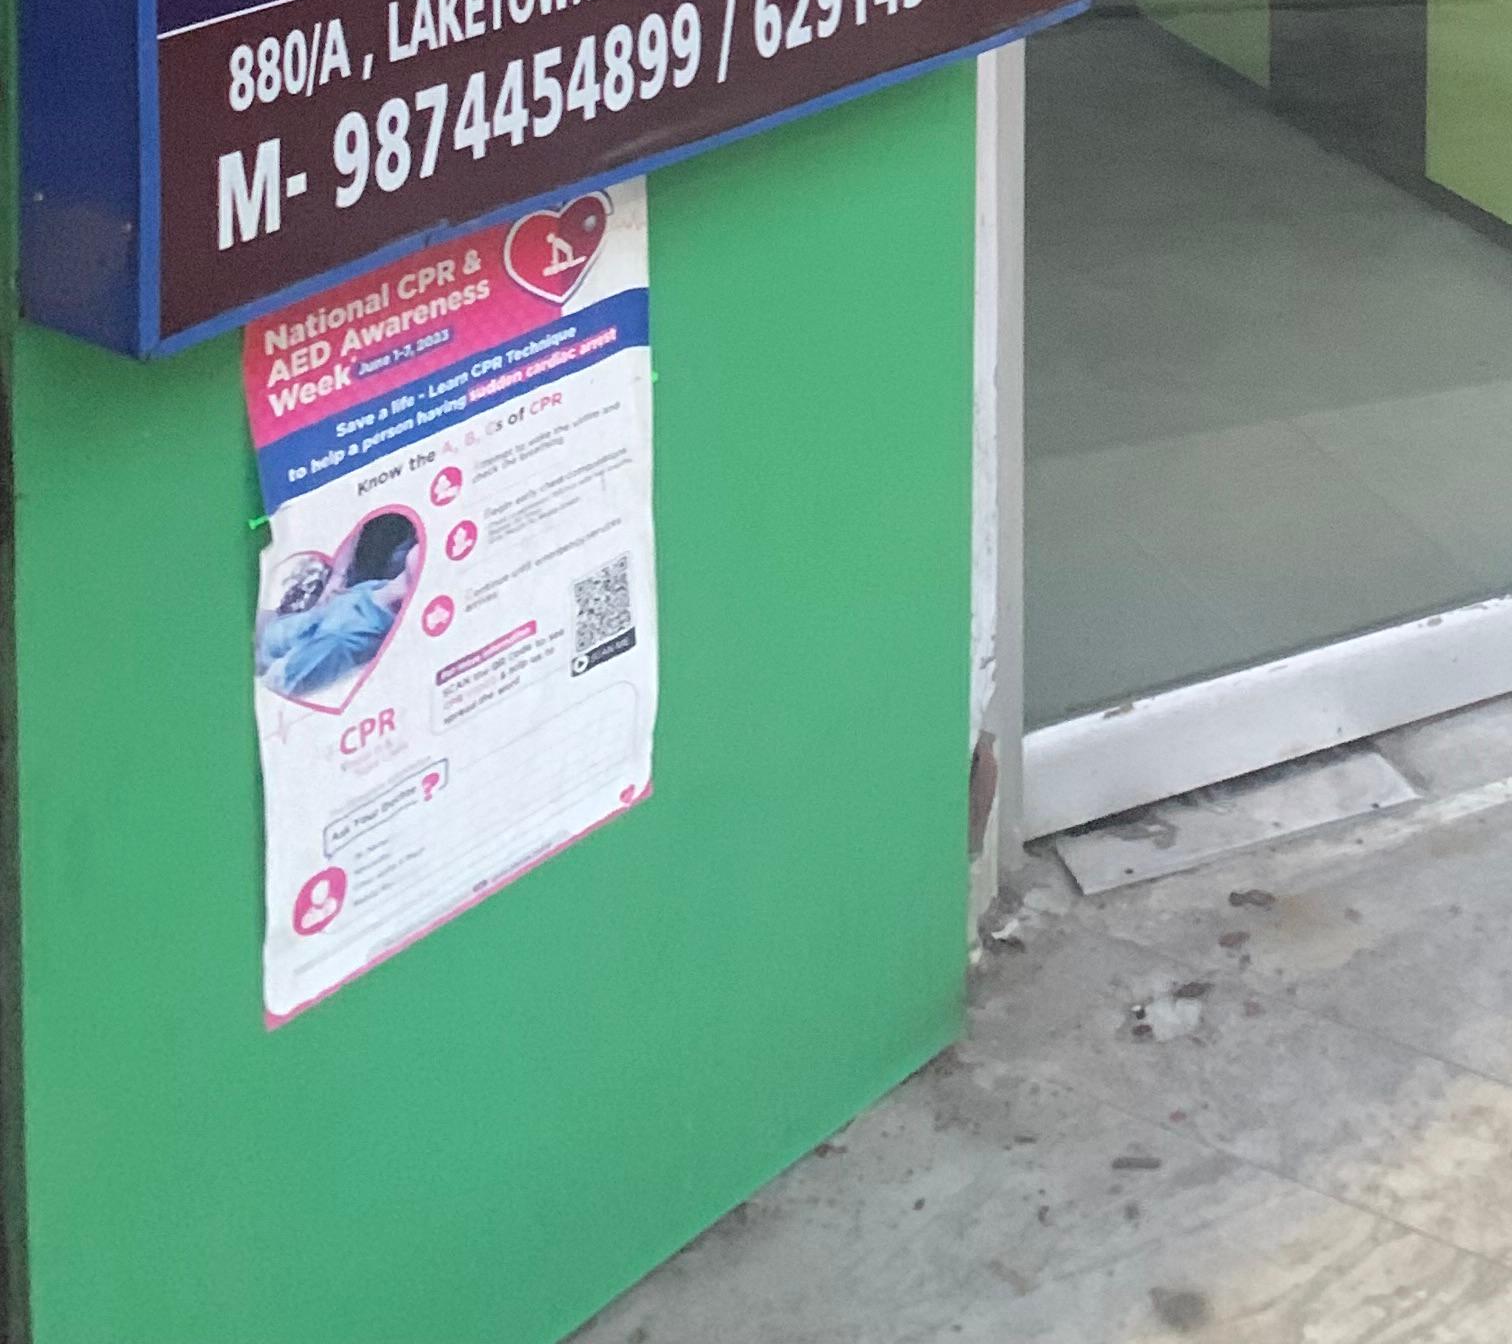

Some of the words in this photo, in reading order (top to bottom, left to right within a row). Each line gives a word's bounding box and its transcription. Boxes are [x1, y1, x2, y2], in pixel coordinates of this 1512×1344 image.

[217, 137, 307, 251] M-
[333, 3, 702, 208] 9874454899
[264, 283, 389, 356] National
[397, 259, 456, 299] CPR
[462, 249, 481, 275] &
[267, 340, 331, 388] AED
[340, 279, 490, 357] Awareness
[268, 363, 351, 417] Week
[288, 466, 307, 482] to
[311, 450, 345, 474] help
[348, 443, 359, 456] a
[362, 418, 414, 453] person
[416, 395, 467, 426] having
[468, 371, 523, 402] sudden
[525, 348, 577, 378] cardiac
[336, 414, 375, 438] Save
[378, 408, 388, 420] a
[428, 372, 468, 398] Learn
[470, 356, 503, 378] CPR
[506, 327, 577, 363] Technique
[357, 465, 404, 496] Know
[408, 450, 436, 471] the
[508, 407, 525, 425] of
[529, 392, 563, 416] CPR
[339, 707, 395, 755] CPR
